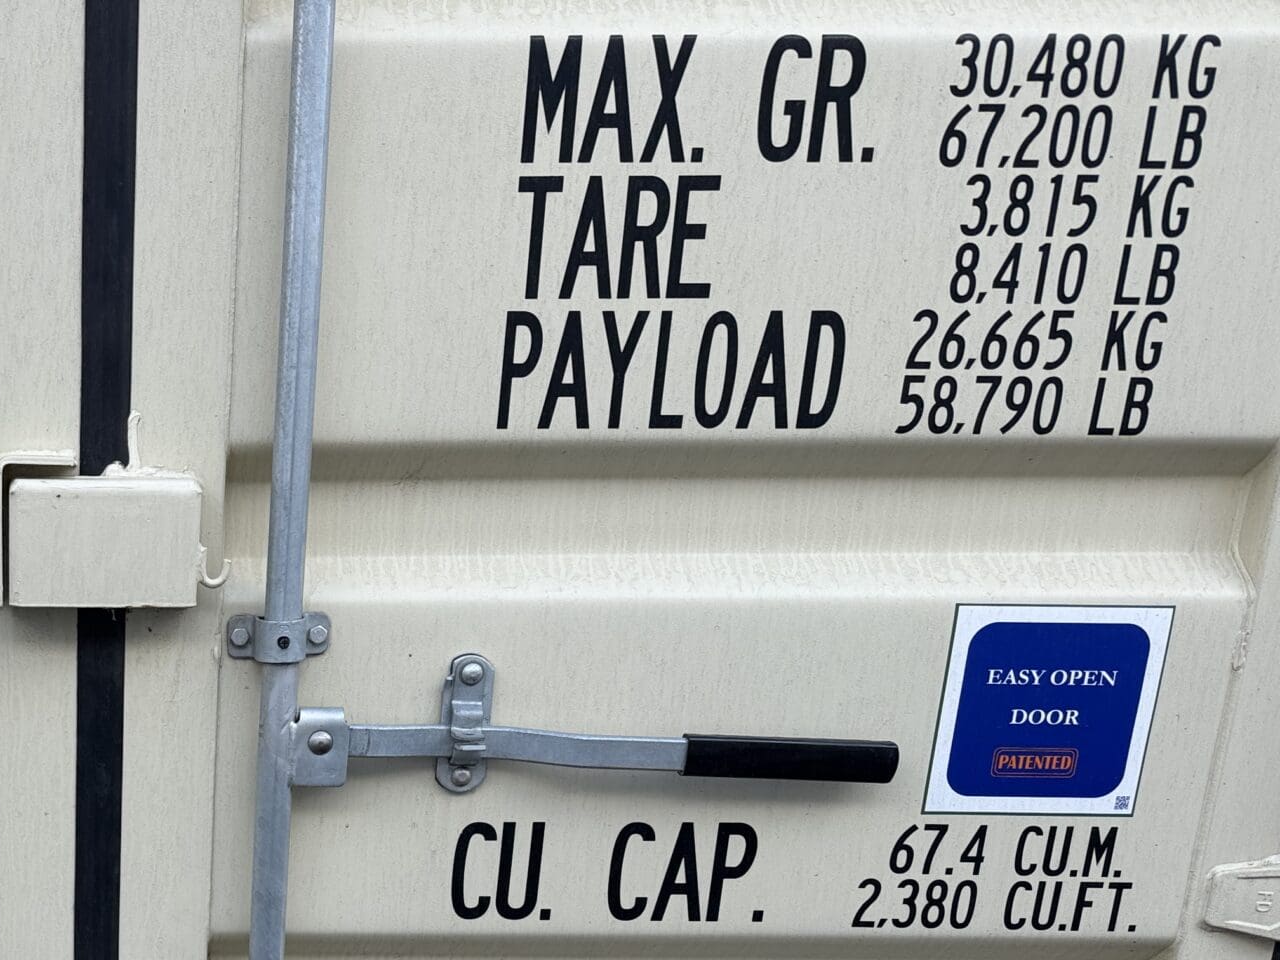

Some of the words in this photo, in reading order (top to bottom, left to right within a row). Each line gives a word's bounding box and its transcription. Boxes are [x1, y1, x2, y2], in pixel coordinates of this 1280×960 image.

[950, 34, 1125, 98] 30,480
[1152, 35, 1221, 99] KG
[521, 35, 703, 163] MAX.
[758, 35, 874, 162] GR.
[940, 104, 1112, 168] 67,200
[1139, 105, 1206, 169] LB
[518, 175, 721, 299] TARE
[960, 174, 1099, 237] 3,815
[1126, 175, 1194, 238] KG
[950, 243, 1088, 304] 8,410
[1114, 244, 1179, 305] LB
[497, 311, 845, 429] PAYLOAD
[906, 309, 1074, 370] 26,665
[1101, 311, 1167, 371] KG
[895, 375, 1063, 435] 58,790
[1088, 377, 1153, 436] LB
[987, 669, 1046, 685] EASY
[1050, 669, 1118, 686] OPEN
[1009, 709, 1079, 725] DOOR
[998, 755, 1072, 769] PATENTED
[451, 822, 551, 920] CU.
[608, 822, 764, 922] CAP.
[890, 824, 987, 875] 67.4
[1015, 826, 1121, 877] CU.M.
[852, 879, 977, 929] 2,380
[1004, 881, 1136, 932] CU.FT.
